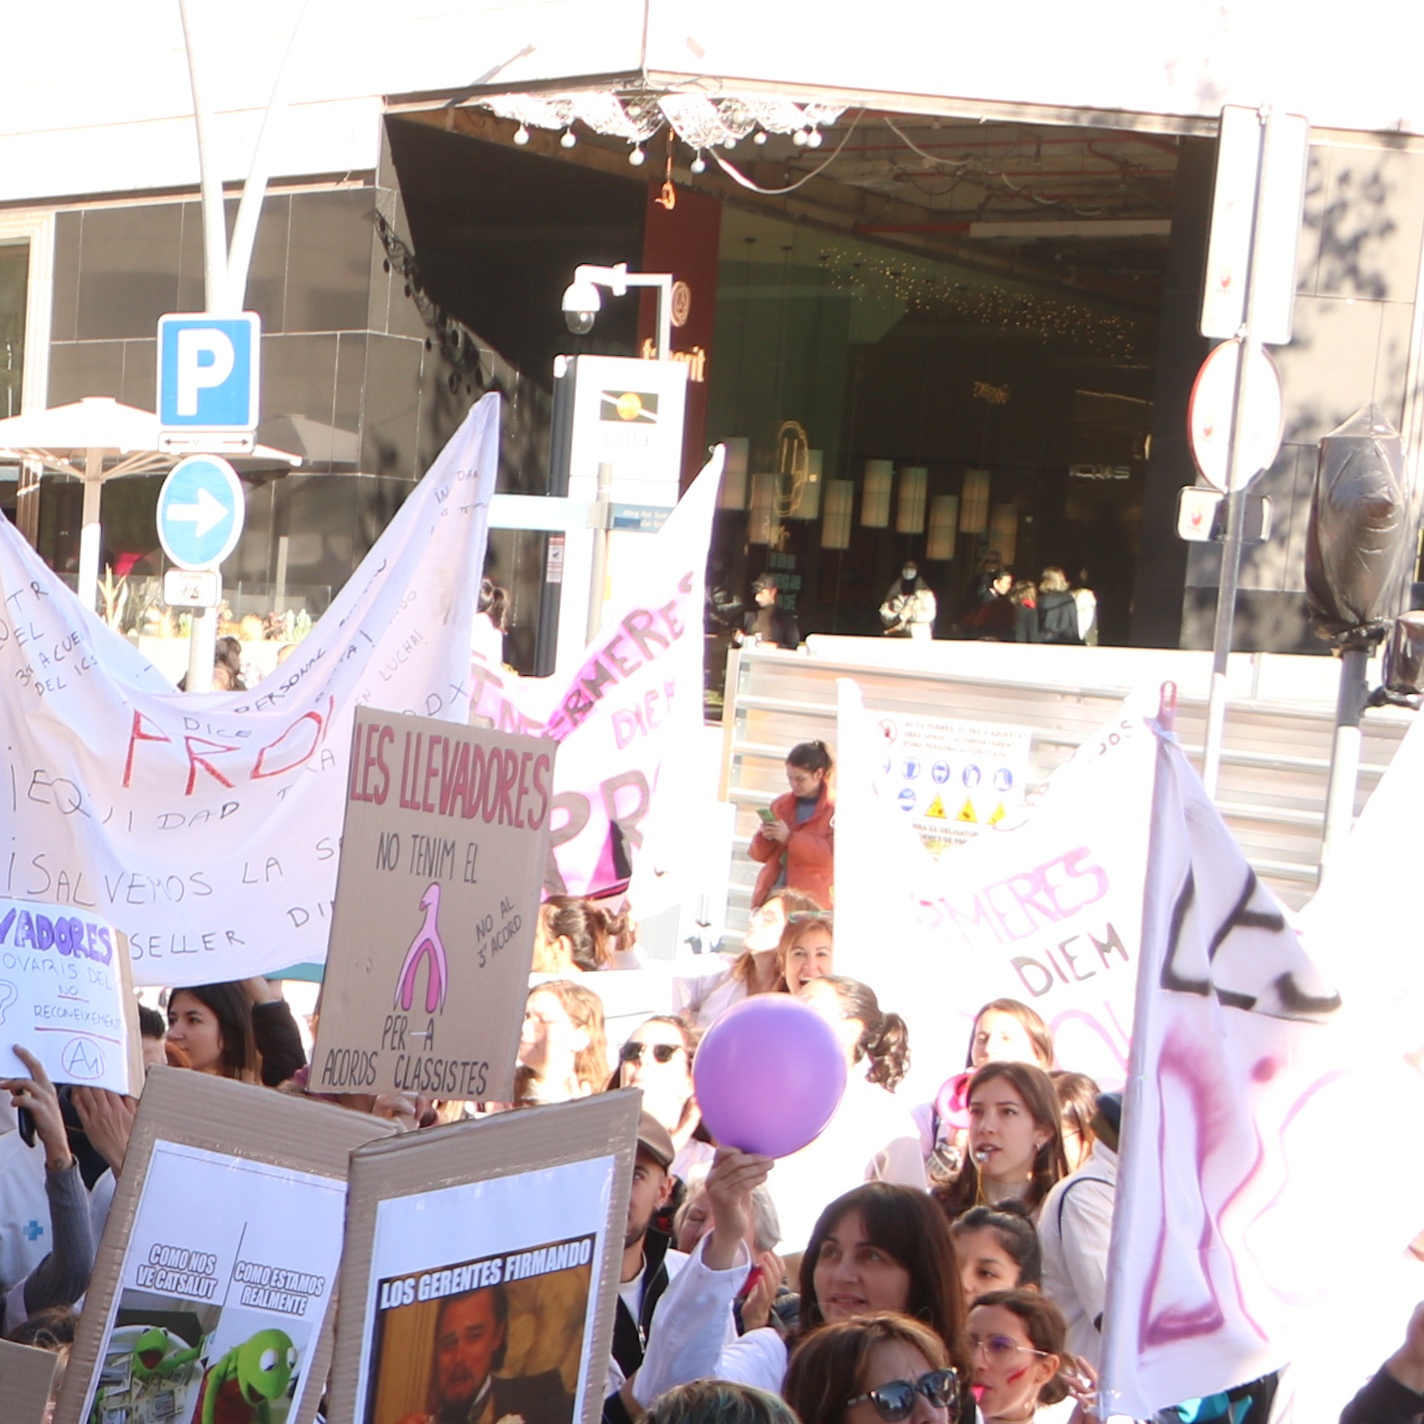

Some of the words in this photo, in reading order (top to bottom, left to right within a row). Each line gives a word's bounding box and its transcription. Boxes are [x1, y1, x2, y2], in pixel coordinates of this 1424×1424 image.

[177, 329, 235, 416] P
[350, 722, 395, 805] LES
[398, 730, 550, 832] LLEVADORES
[375, 831, 400, 872] NO
[409, 833, 456, 880] TENIM
[463, 842, 479, 884] EL
[475, 915, 493, 943] NO
[499, 897, 515, 921] AL
[489, 914, 523, 958] ACORD
[1010, 921, 1130, 999] DIEM
[58, 984, 79, 997] NO
[381, 1014, 407, 1052] PER
[423, 1017, 435, 1051] A
[321, 1047, 379, 1088] ACORDS
[393, 1052, 489, 1096] CLASSISTES
[148, 1243, 186, 1269] COMO
[186, 1251, 217, 1275] NOS
[234, 1262, 271, 1287] COMO
[270, 1268, 326, 1297] ESTAMOS
[379, 1282, 417, 1311] LOS
[416, 1264, 504, 1300] GERENTES
[502, 1239, 594, 1284] FIRMANDO
[135, 1264, 157, 1288] VE
[154, 1268, 219, 1300] CATSALUT
[239, 1285, 311, 1316] REALMENTE
